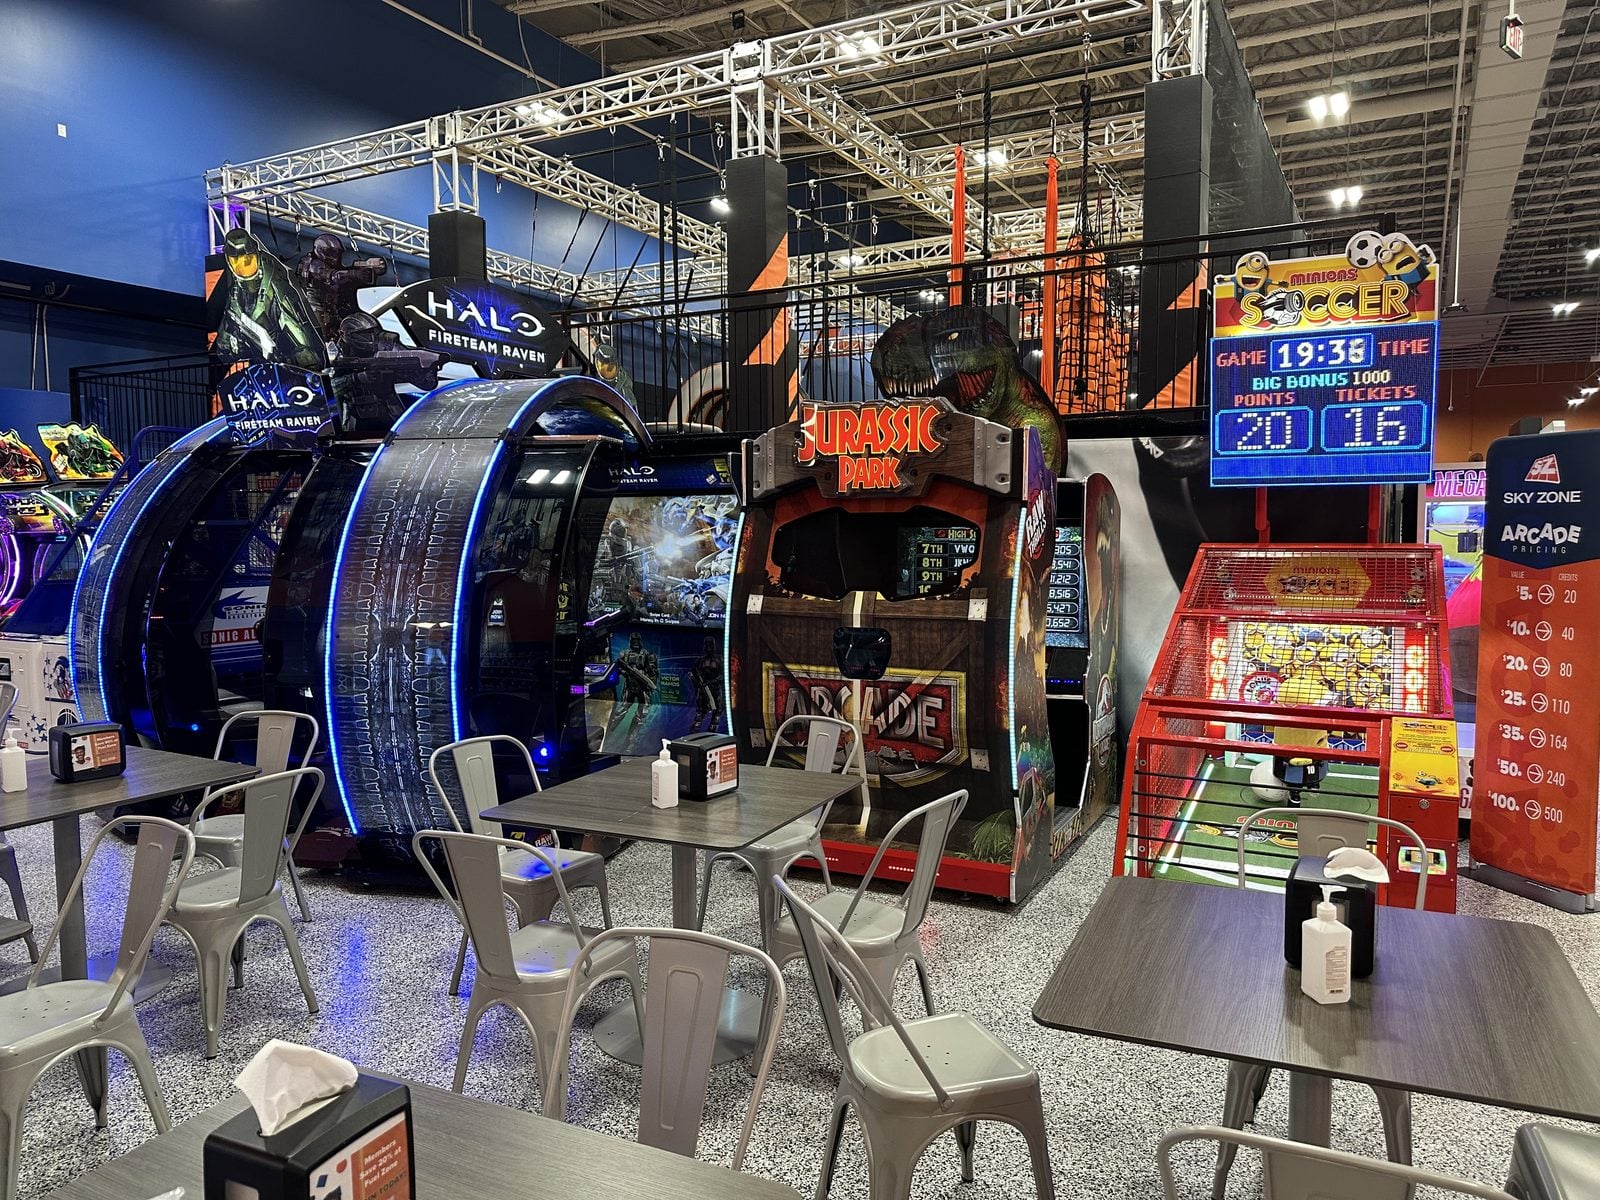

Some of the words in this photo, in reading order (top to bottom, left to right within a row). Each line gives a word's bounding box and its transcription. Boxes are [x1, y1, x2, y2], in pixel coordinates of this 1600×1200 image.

[427, 291, 545, 337] HALO
[428, 329, 498, 354] FIRETEAM
[502, 345, 545, 363] RAVEN
[1216, 350, 1267, 367] GAME
[1378, 338, 1430, 356] TIME
[1252, 376, 1282, 391] BIG
[1286, 372, 1348, 388] BONUS
[1352, 370, 1391, 385] 1000
[227, 386, 316, 412] HALO
[1234, 392, 1296, 407] POINTS
[1335, 386, 1417, 402] TICKETS
[235, 418, 284, 430] FIRETEAM
[285, 415, 321, 427] RAVEN
[1237, 411, 1292, 450] 20
[1344, 406, 1407, 447] 16
[797, 404, 942, 462] JURASSIC
[838, 455, 901, 493] PARK
[1433, 470, 1487, 497] MEGA
[1503, 491, 1535, 504] SKY
[1536, 490, 1582, 504] ZONE
[1500, 522, 1582, 545] ARCADE
[921, 543, 943, 554] 7TH
[1512, 545, 1567, 554] PRICING
[921, 557, 943, 568] 8TH
[921, 571, 943, 581] 9TH
[1510, 570, 1525, 579] VALUE
[1558, 573, 1579, 582] CREDITS
[1563, 589, 1577, 604] 20
[202, 630, 239, 645] SONIC
[1561, 627, 1575, 641] 40
[1559, 662, 1573, 678] 80
[1552, 698, 1570, 715] 110
[1550, 734, 1568, 751] 164
[1306, 765, 1316, 775] 10
[1546, 770, 1565, 787] 240
[1544, 807, 1563, 824] 500
[364, 1140, 397, 1166] Members
[360, 1164, 377, 1180] Save
[394, 1146, 402, 1156] at
[364, 1173, 380, 1188] Fuel
[381, 1160, 399, 1176] Zone
